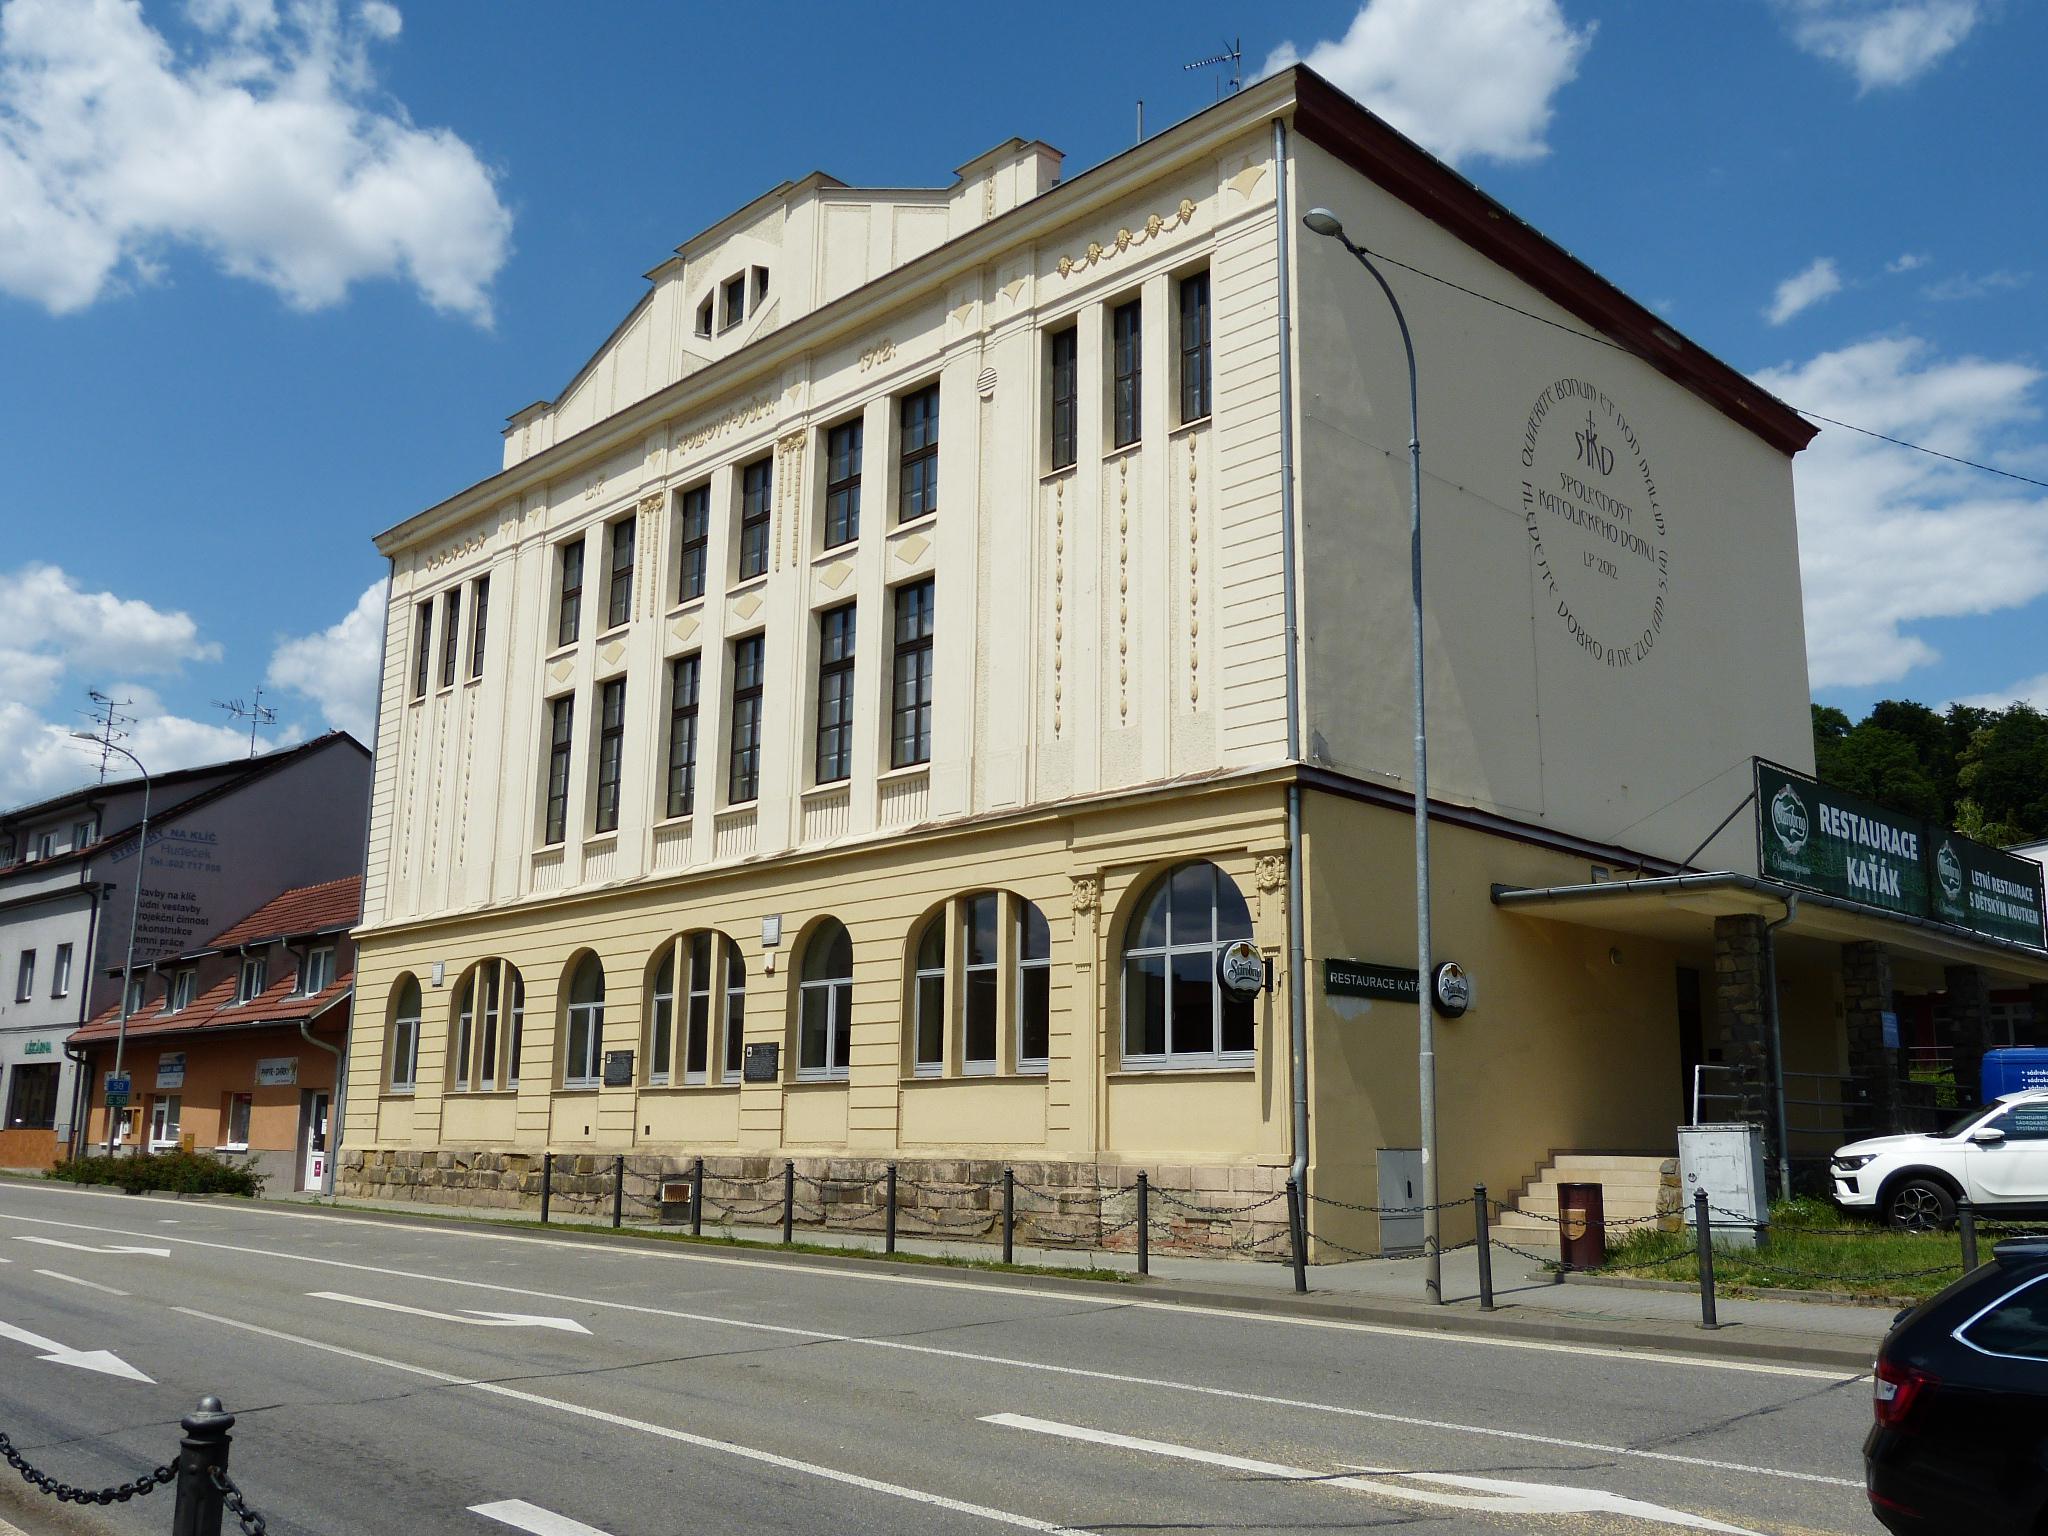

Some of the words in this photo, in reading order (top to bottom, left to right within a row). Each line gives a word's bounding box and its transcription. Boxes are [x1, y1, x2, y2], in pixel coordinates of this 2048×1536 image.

[1553, 378, 1597, 402] BONUM
[1600, 392, 1615, 417] ET
[1616, 412, 1640, 456] NON
[1620, 529, 1655, 563] DOMU
[1596, 557, 1619, 580] 2012
[1557, 600, 1603, 661] DOBRO
[1633, 628, 1654, 661] ZLO
[1819, 803, 1918, 860] RESTAURACE
[1846, 853, 1900, 898] KAŤÁK
[1971, 869, 1991, 890] LETNÍ
[1991, 876, 2034, 903] RESTAURACE
[1969, 891, 1975, 907] S
[1975, 891, 2007, 917] DĚTSKÝM
[2007, 903, 2039, 925] KOUTKEM
[1330, 972, 1395, 990] RESTAURACE
[109, 1096, 115, 1105] E
[116, 1096, 127, 1105] 50
[113, 1082, 124, 1090] 50
